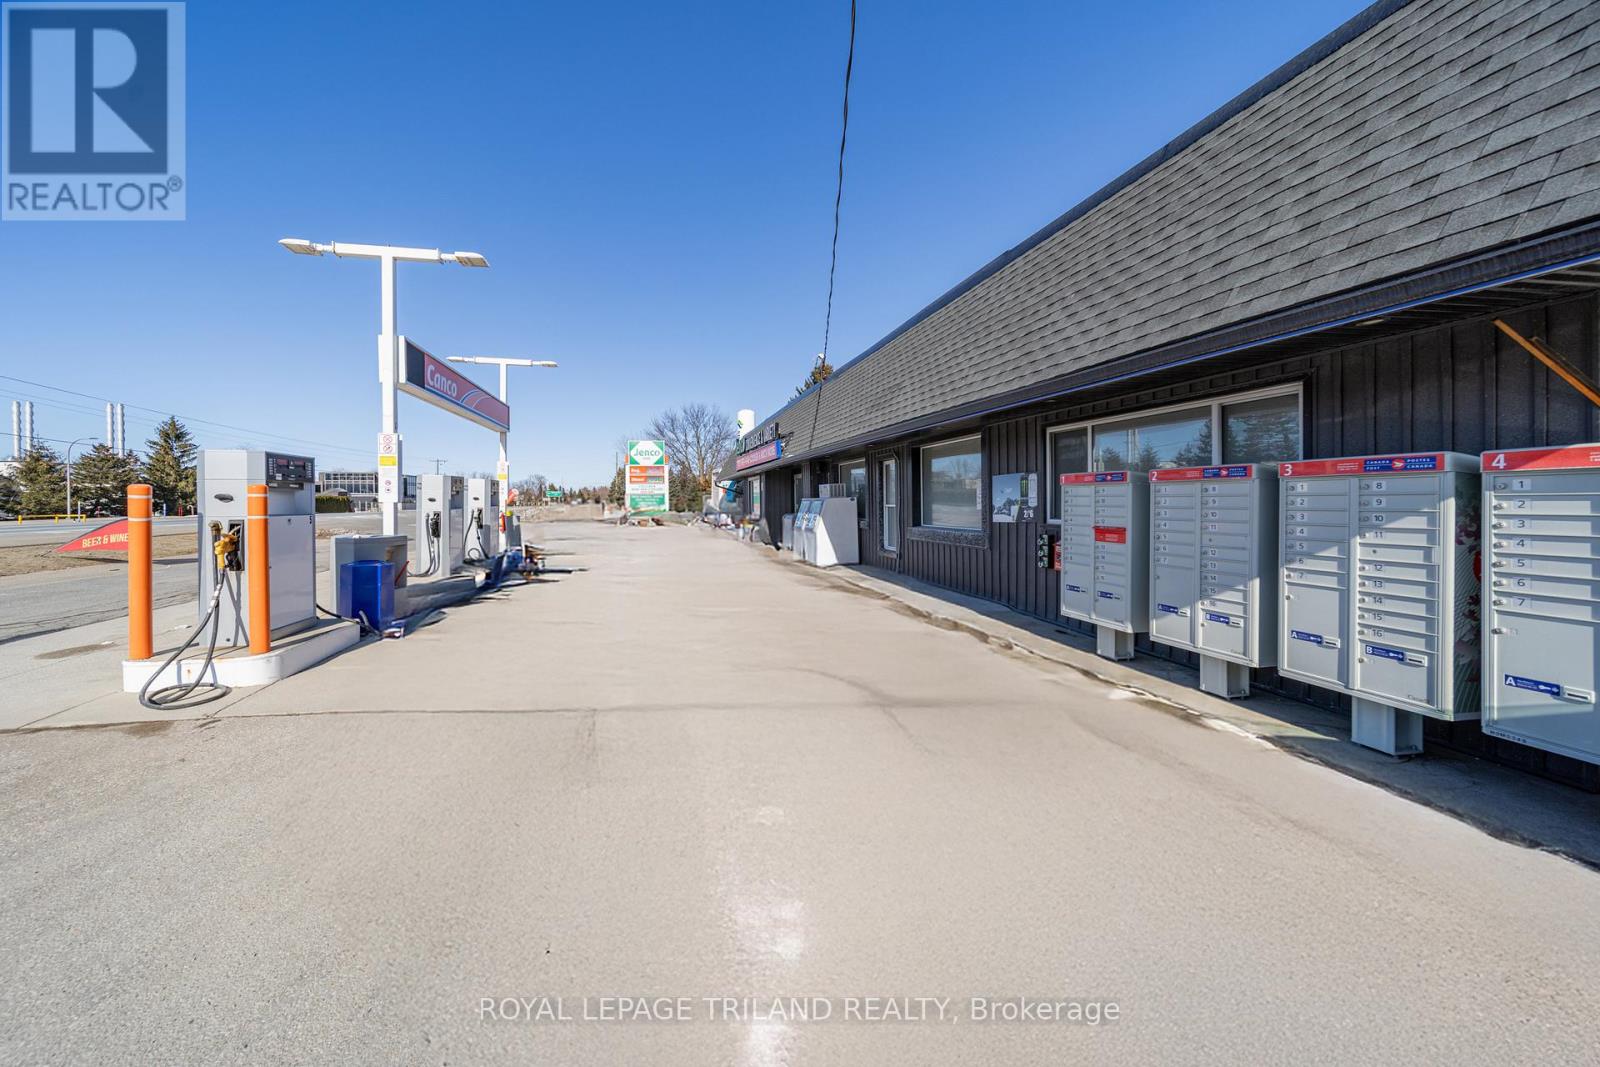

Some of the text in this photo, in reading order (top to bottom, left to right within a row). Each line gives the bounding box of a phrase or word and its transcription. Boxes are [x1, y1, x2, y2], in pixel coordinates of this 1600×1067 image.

[427, 364, 457, 398] Canco
[633, 448, 660, 457] Jenco
[1492, 454, 1506, 468] 4
[1284, 464, 1292, 476] 3
[1152, 472, 1157, 480] 2
[1518, 520, 1525, 528] 3
[82, 536, 102, 548] BEER
[1516, 539, 1524, 547] 4
[1518, 559, 1524, 567] 5
[1291, 631, 1298, 639] A
[1366, 646, 1372, 654] B
[1506, 676, 1516, 686] A
